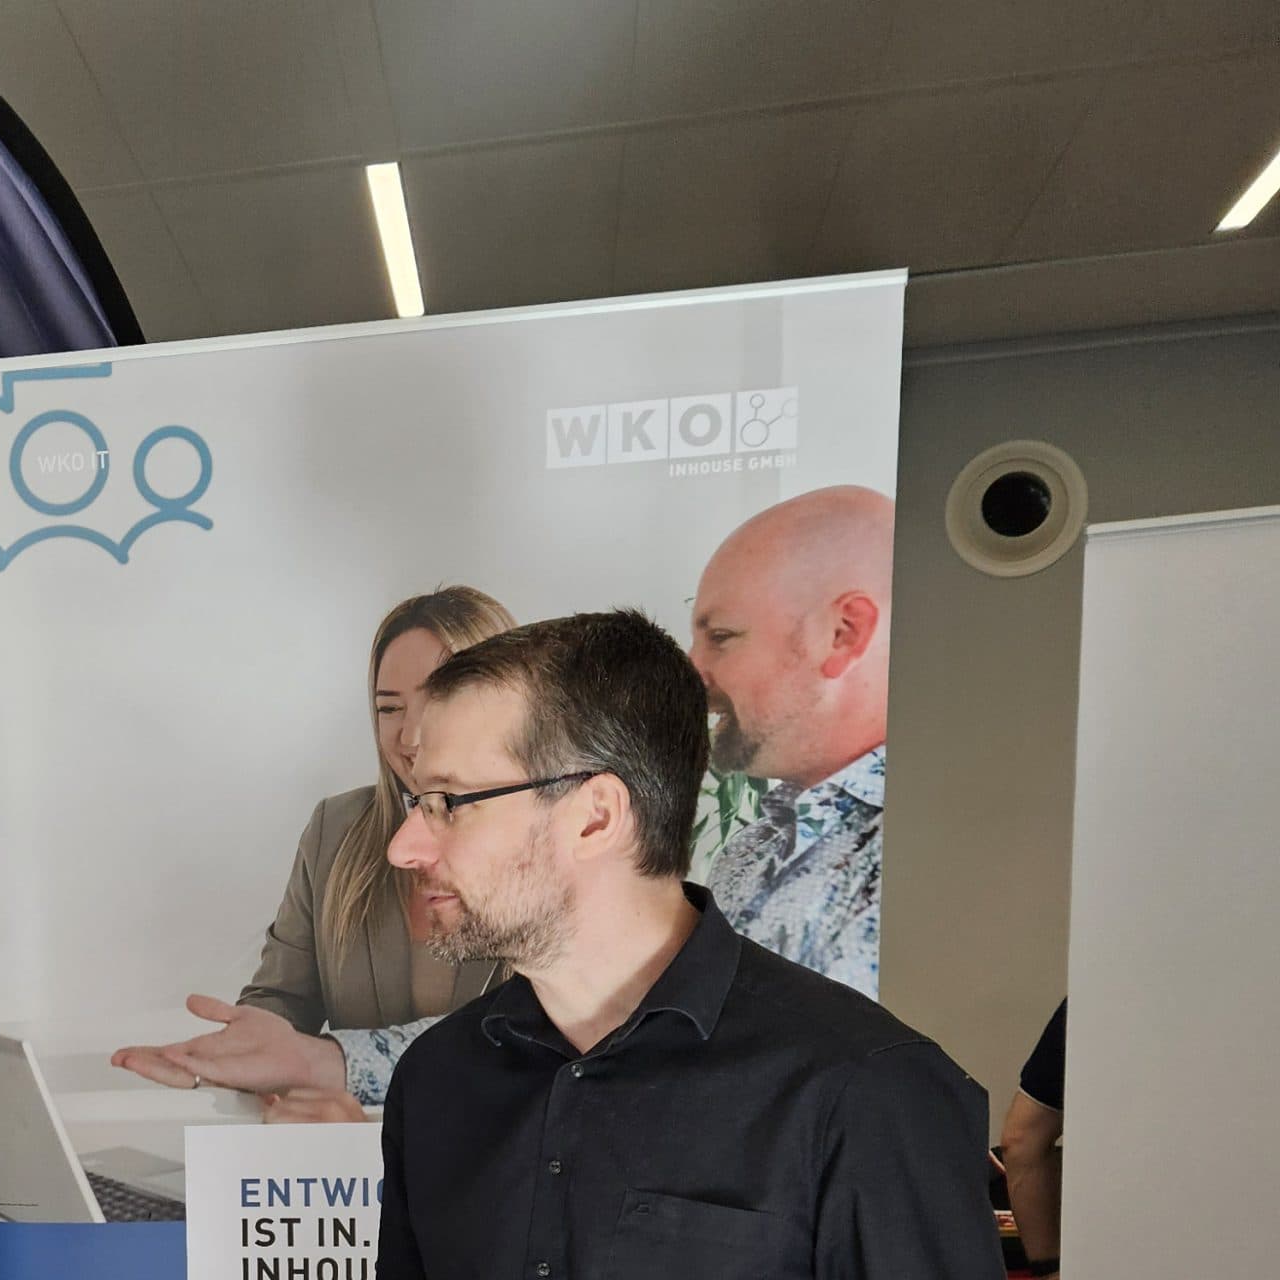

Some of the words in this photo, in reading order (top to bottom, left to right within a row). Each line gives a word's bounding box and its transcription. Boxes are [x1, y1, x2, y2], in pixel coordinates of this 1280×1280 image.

[552, 403, 722, 458] WKO
[38, 453, 84, 473] WKO
[91, 450, 109, 469] IT
[670, 459, 742, 477] INHOUSE
[748, 455, 797, 470] GMBH
[241, 1178, 384, 1207] ENTWI
[241, 1218, 301, 1247] IST
[318, 1218, 370, 1247] IN.
